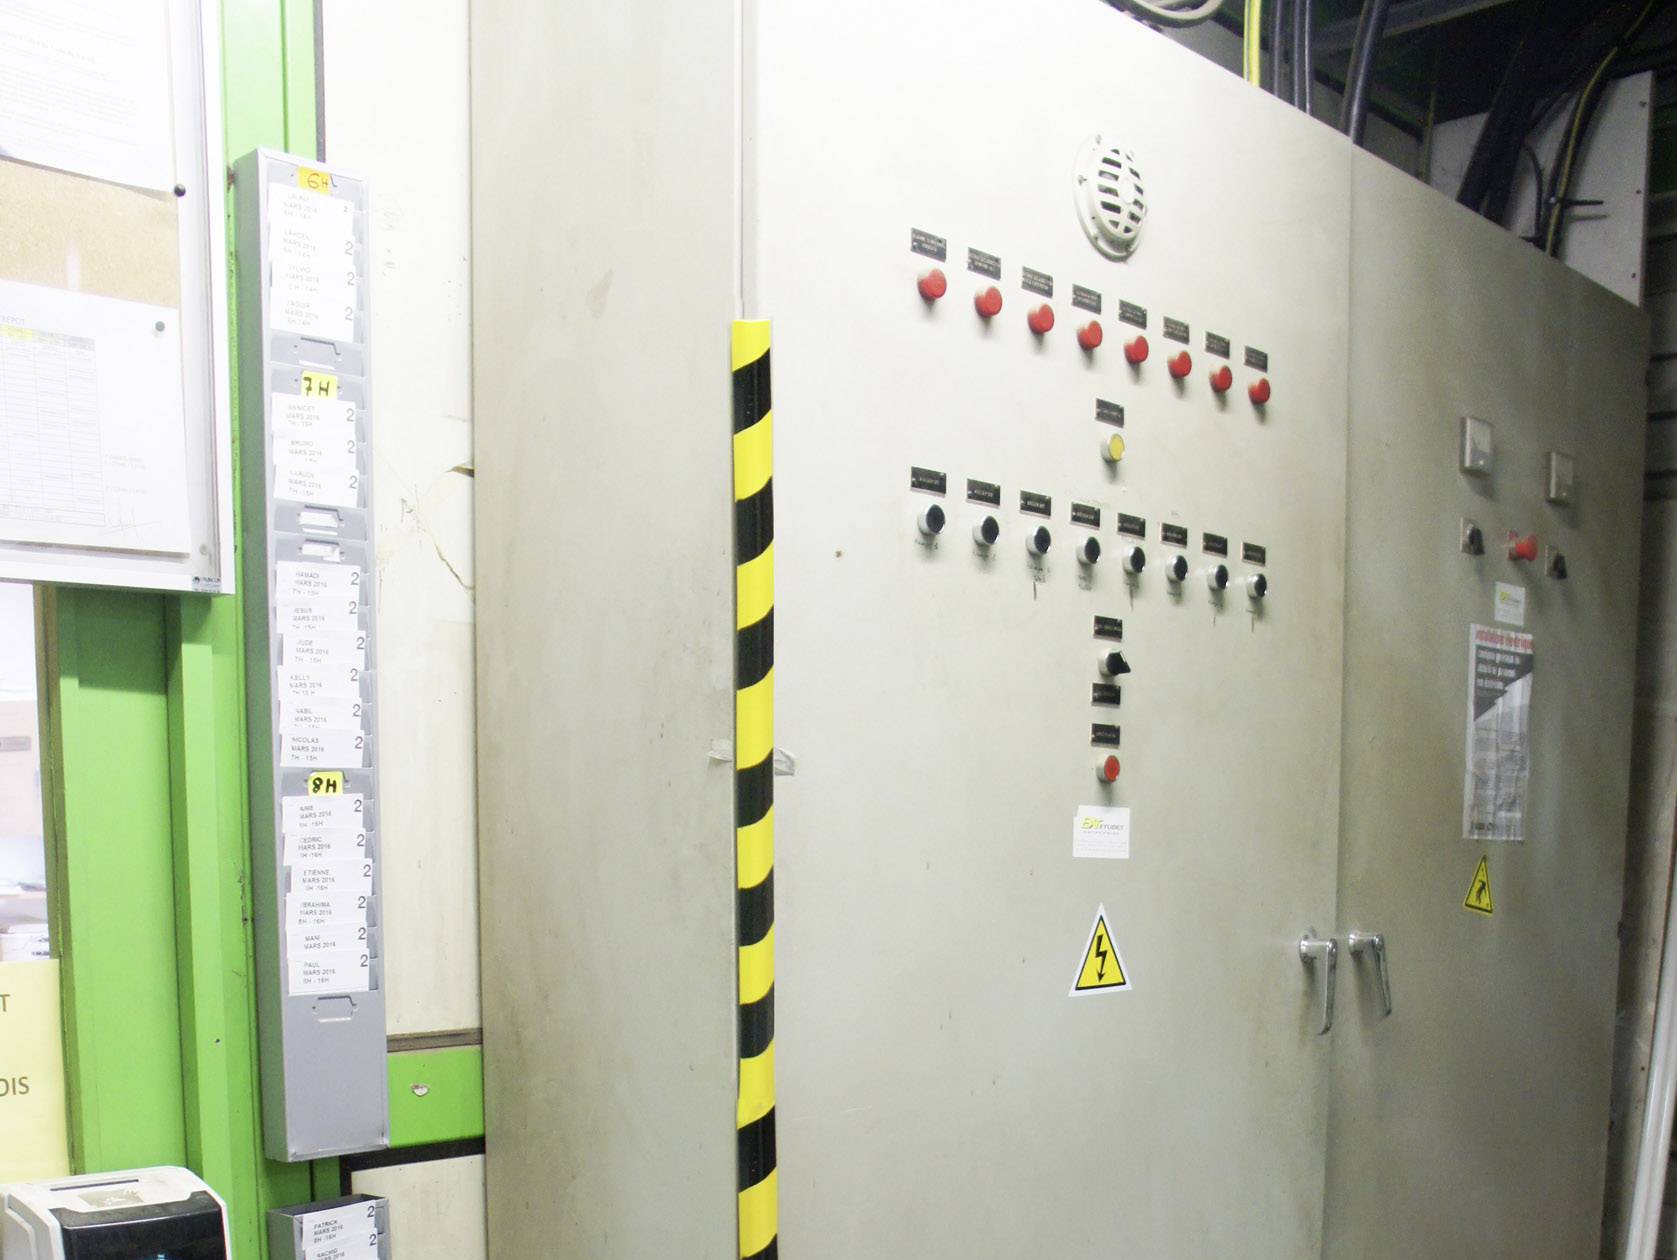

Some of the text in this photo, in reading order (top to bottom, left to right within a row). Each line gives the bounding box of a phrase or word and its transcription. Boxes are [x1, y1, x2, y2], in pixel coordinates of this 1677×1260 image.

[343, 205, 348, 213] 2
[345, 241, 354, 255] 2
[346, 271, 355, 286] 2
[345, 306, 353, 321] 2
[346, 408, 355, 422] 2
[347, 440, 355, 454] 2
[350, 475, 358, 489] 2
[351, 571, 360, 585] 2
[349, 601, 357, 614] 2
[356, 636, 365, 650] 2
[350, 668, 358, 682] 2
[352, 703, 361, 718] 2
[354, 736, 363, 749] 2
[312, 777, 337, 794] 8H
[354, 799, 362, 813] 2
[357, 833, 365, 847] 2
[363, 864, 371, 878] 2
[358, 896, 366, 909] 2
[358, 927, 366, 940] 2
[360, 954, 368, 967] 2
[367, 1205, 375, 1218] 2
[314, 1220, 338, 1229] PATRICK
[369, 1233, 377, 1246] 2
